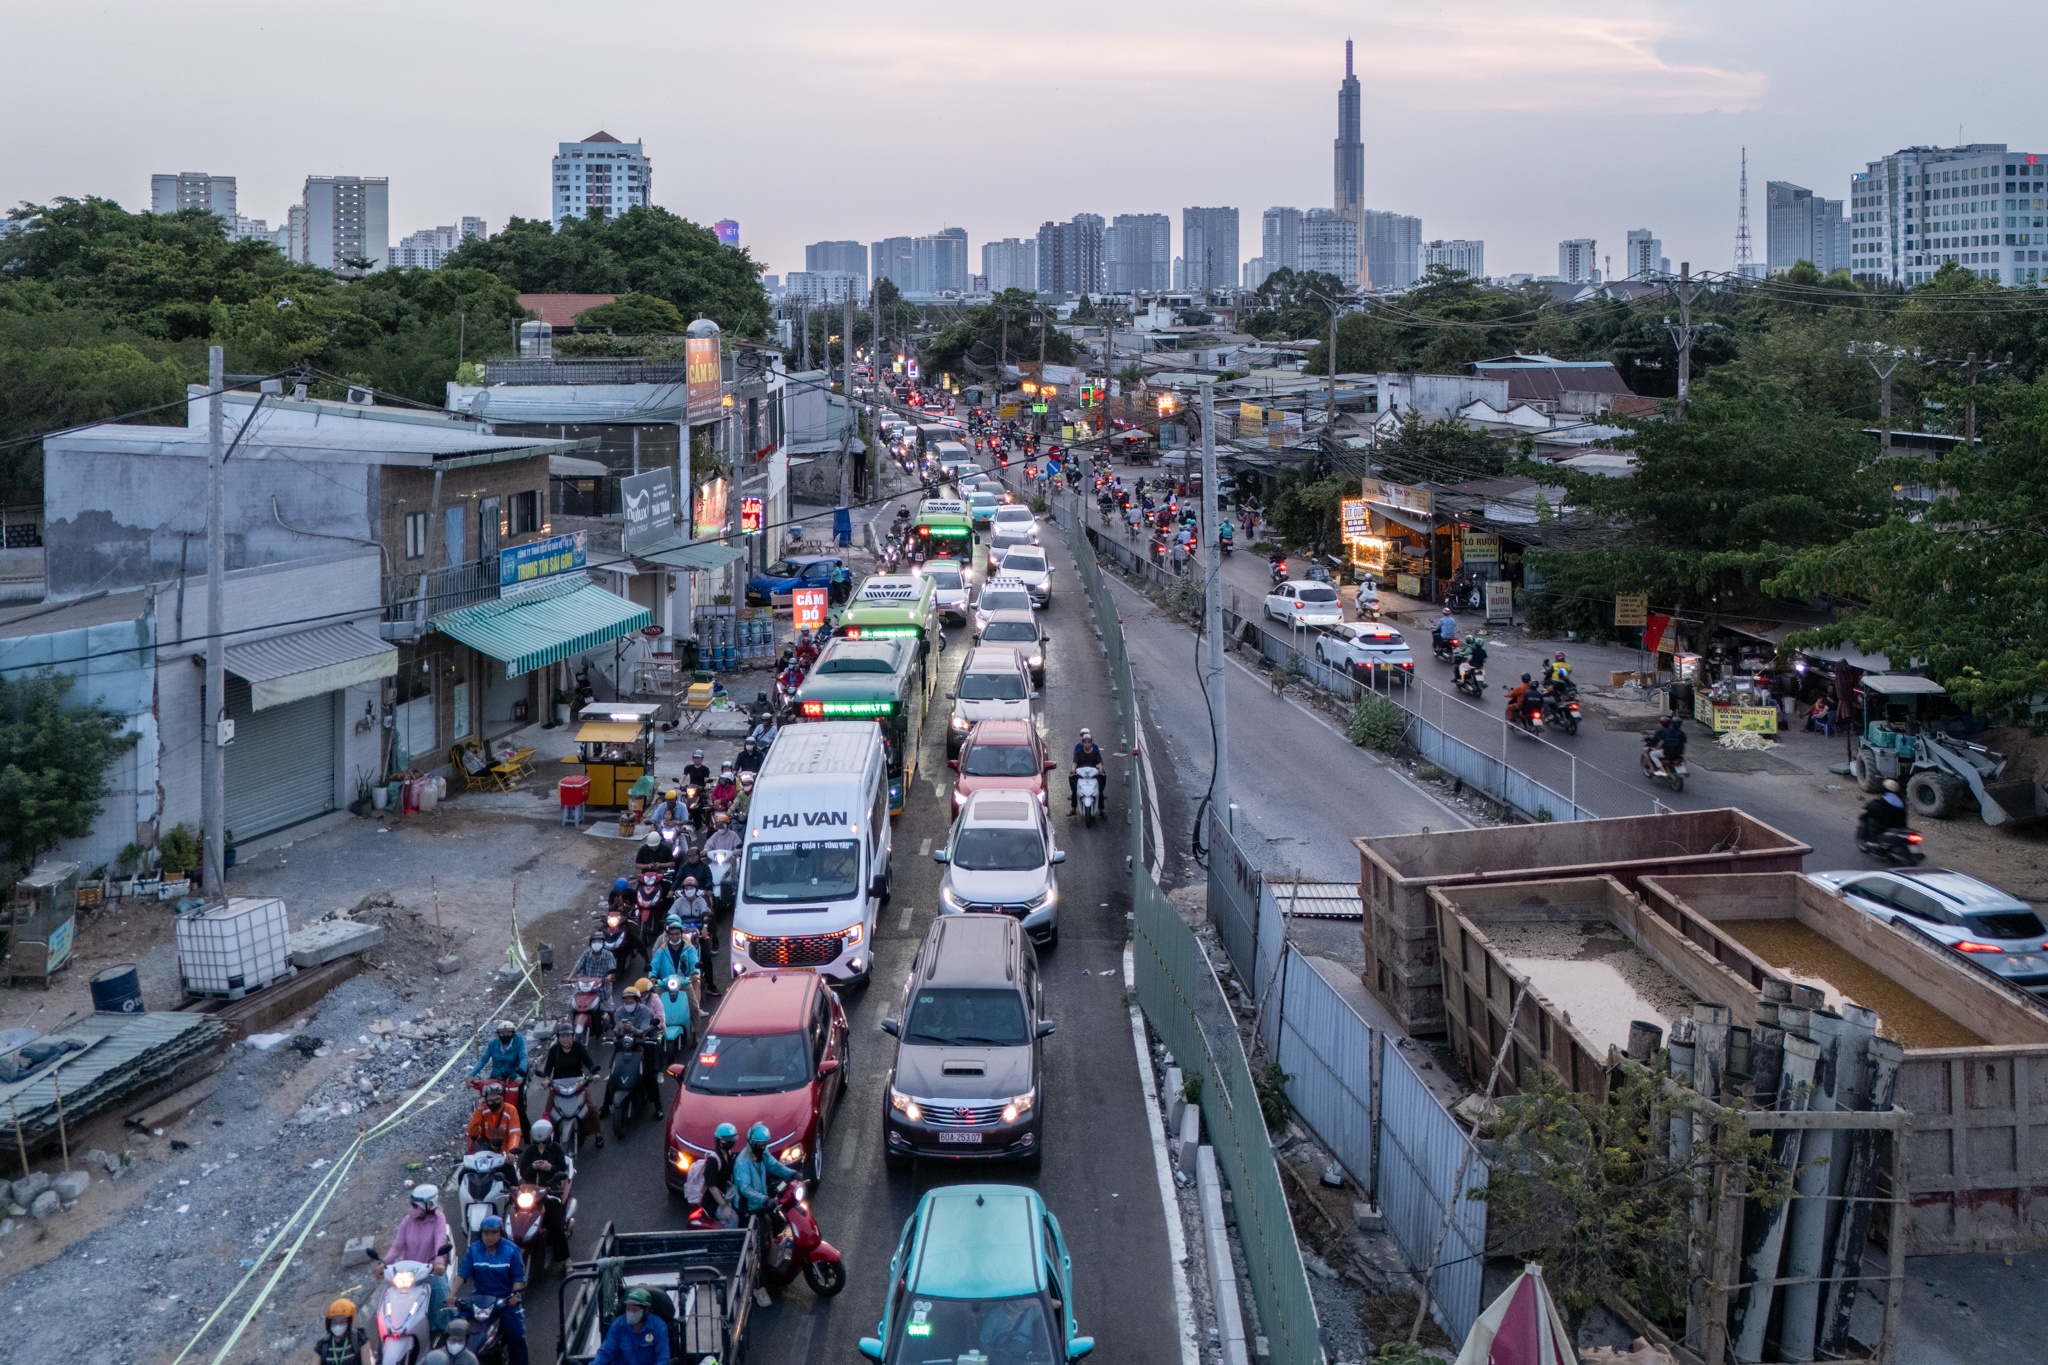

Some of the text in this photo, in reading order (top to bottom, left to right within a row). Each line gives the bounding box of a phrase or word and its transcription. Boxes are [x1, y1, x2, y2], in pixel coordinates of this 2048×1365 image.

[1464, 537, 1498, 547] LÒ RƯỢU
[517, 560, 538, 580] TRUNG
[549, 552, 560, 573] SÀI
[762, 811, 847, 830] HAI VAN
[772, 843, 784, 852] SƠN
[784, 841, 798, 851] NHẤT
[801, 842, 816, 851] QUẬN
[824, 841, 839, 849] VŨNG
